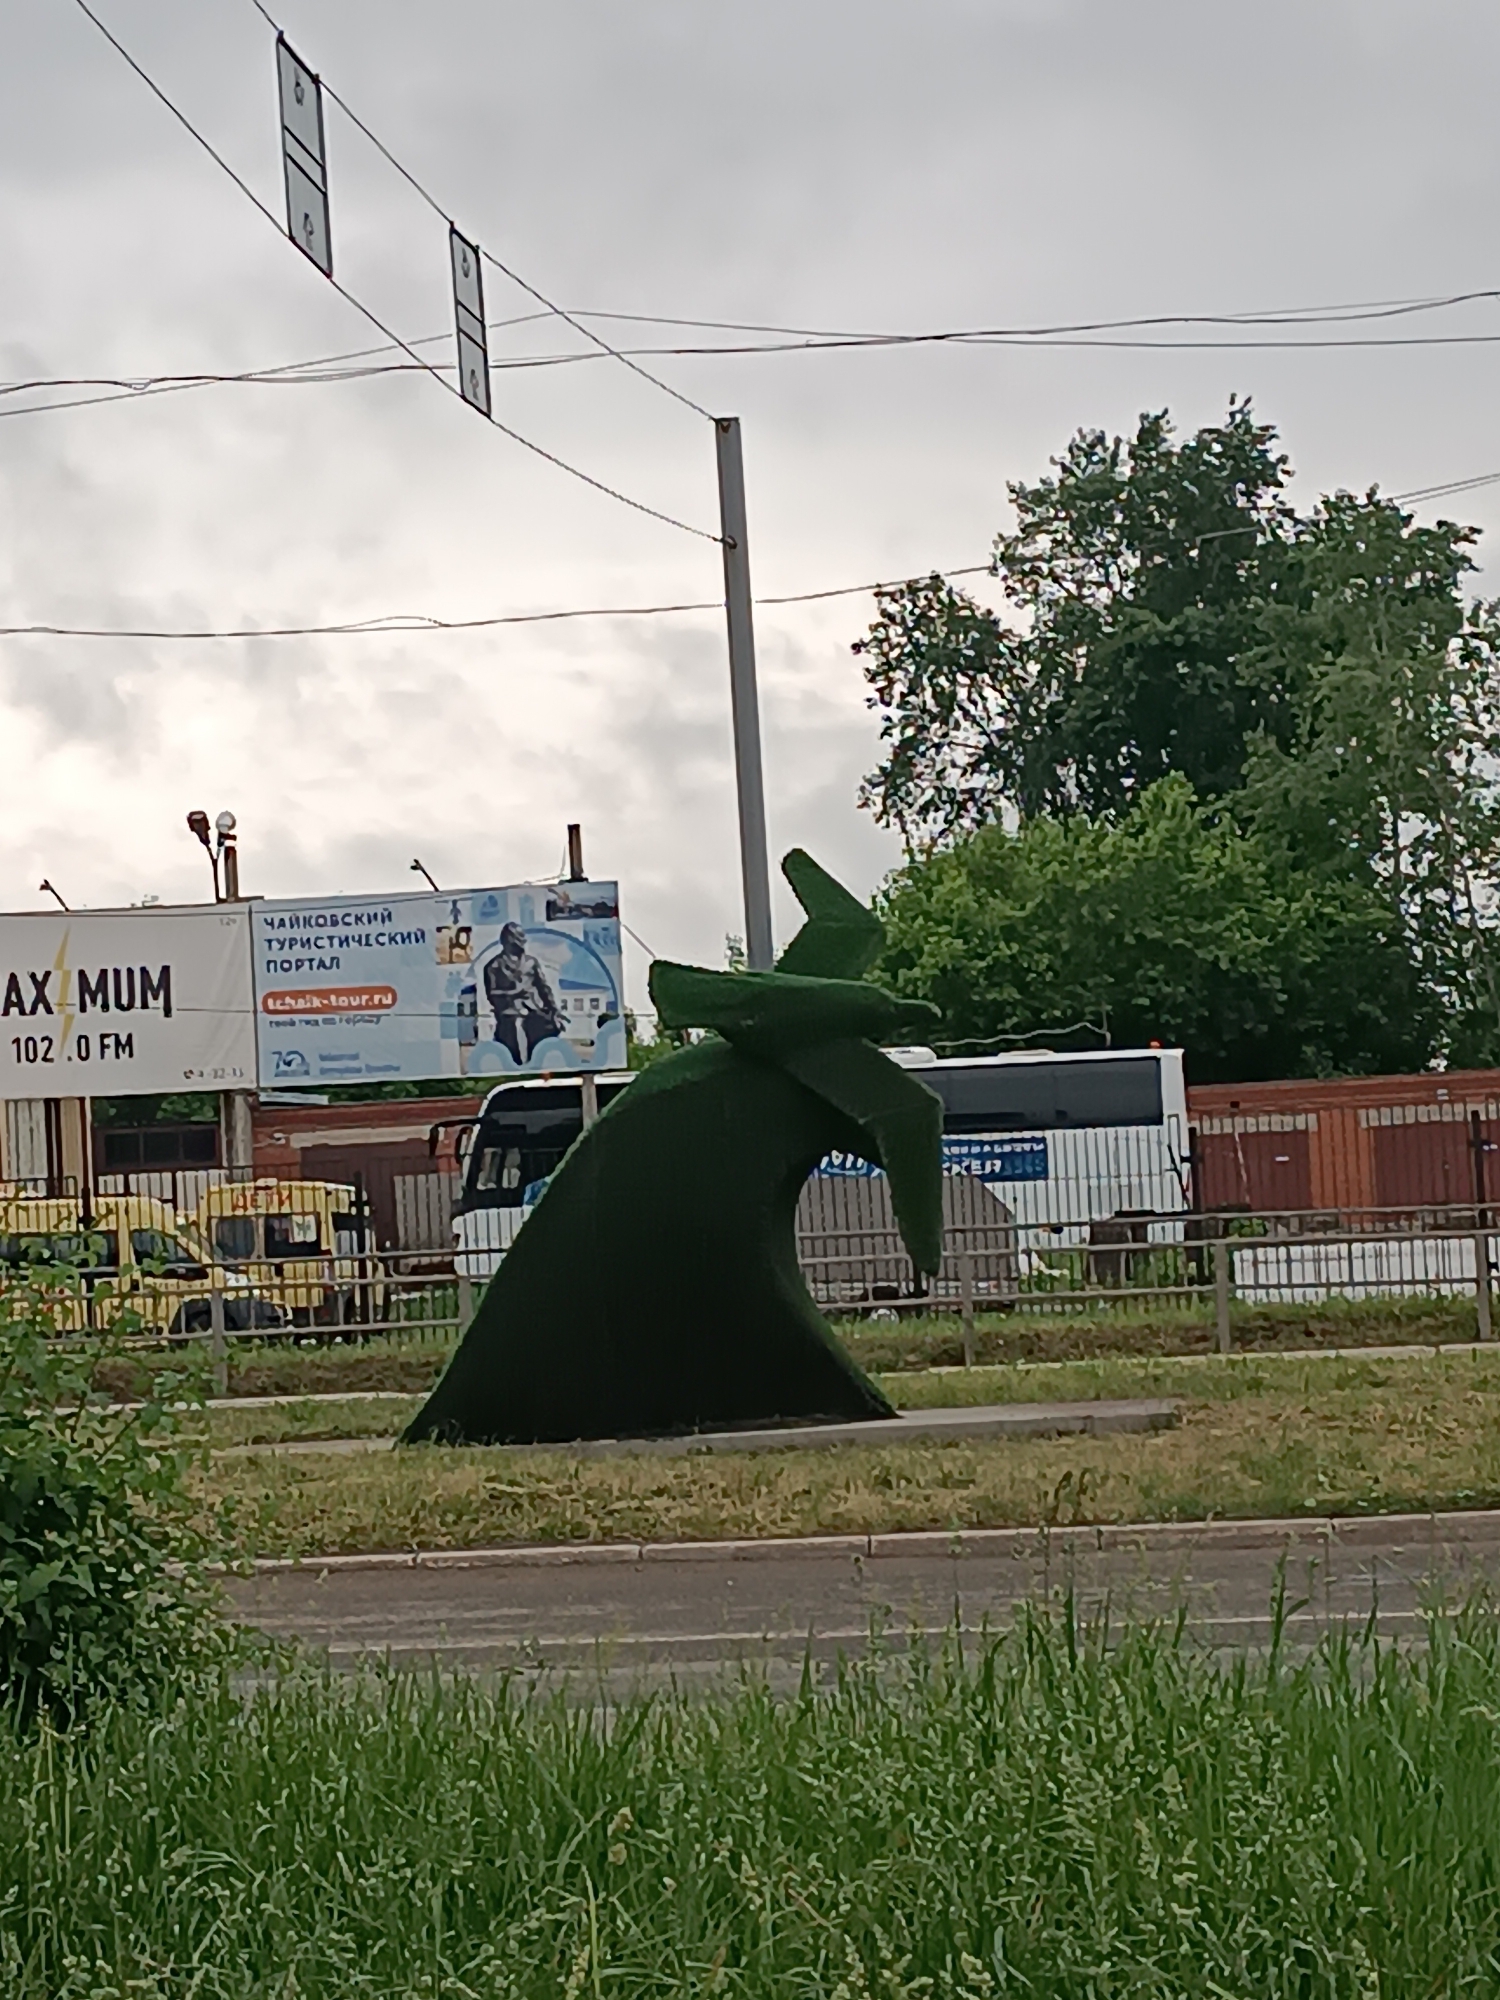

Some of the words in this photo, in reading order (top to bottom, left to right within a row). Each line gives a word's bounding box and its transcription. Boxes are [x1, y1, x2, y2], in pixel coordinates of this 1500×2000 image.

[263, 907, 393, 930] ЧАЙКОВСКИЙ
[263, 928, 426, 951] ТУРИСТИЧЕСКИЙ
[266, 956, 341, 974] ПОРТАЛ
[11, 1034, 90, 1063] 102.0
[99, 1032, 134, 1060] FM
[231, 1187, 292, 1214] ДЕТИ
